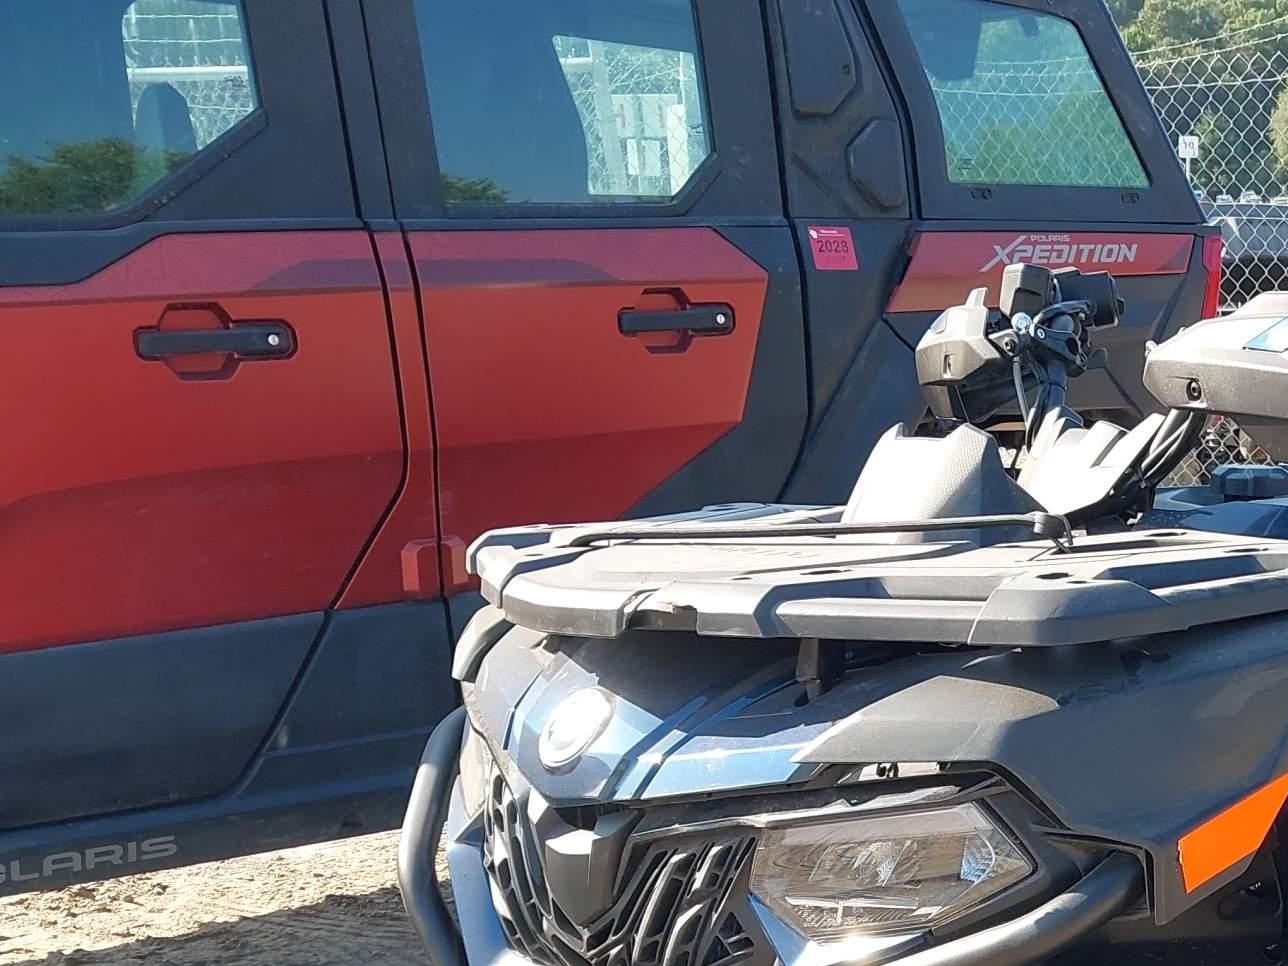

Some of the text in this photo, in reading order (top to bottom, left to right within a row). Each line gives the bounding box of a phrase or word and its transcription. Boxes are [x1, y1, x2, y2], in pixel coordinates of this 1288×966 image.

[978, 235, 1139, 273] XPEDITION
[1030, 234, 1071, 242] POLARIS
[0, 834, 178, 884] LARIS
